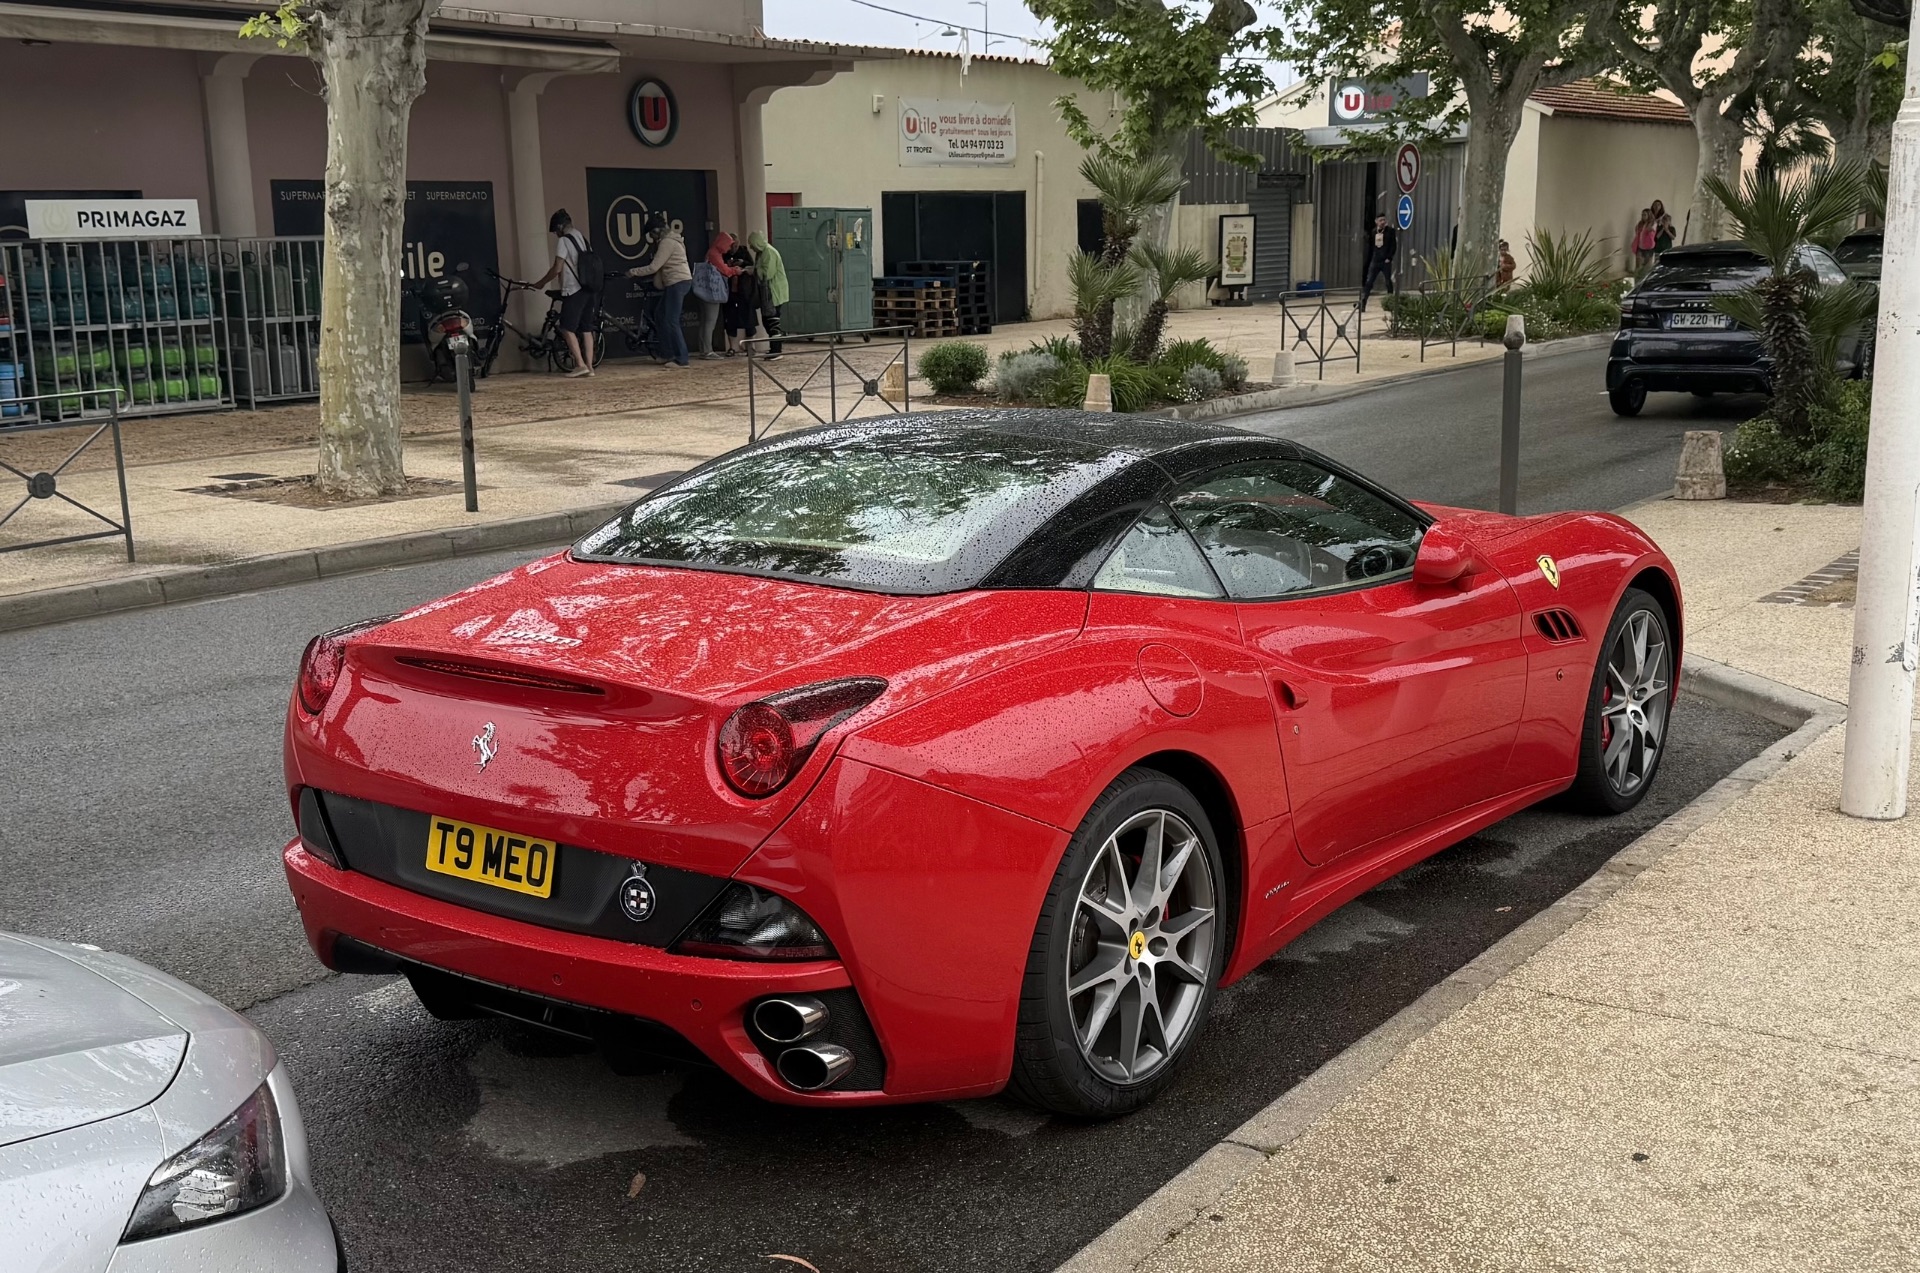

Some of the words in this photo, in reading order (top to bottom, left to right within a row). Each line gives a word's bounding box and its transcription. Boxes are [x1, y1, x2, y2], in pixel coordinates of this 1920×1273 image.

[638, 96, 667, 130] U
[939, 115, 957, 124] vous
[958, 113, 975, 125] livre
[975, 114, 981, 125] à
[982, 115, 1012, 126] domicile
[906, 116, 937, 135] Utile
[913, 146, 932, 154] TROPEZ
[960, 139, 969, 149] 04
[969, 140, 978, 150] 94
[978, 140, 986, 150] 97
[987, 140, 995, 150] 03
[996, 140, 1004, 150] 23
[426, 191, 487, 201] SUPERMERCATO
[78, 210, 186, 228] PRIMAGAZ
[437, 822, 475, 870] T9
[482, 832, 548, 888] MEO
